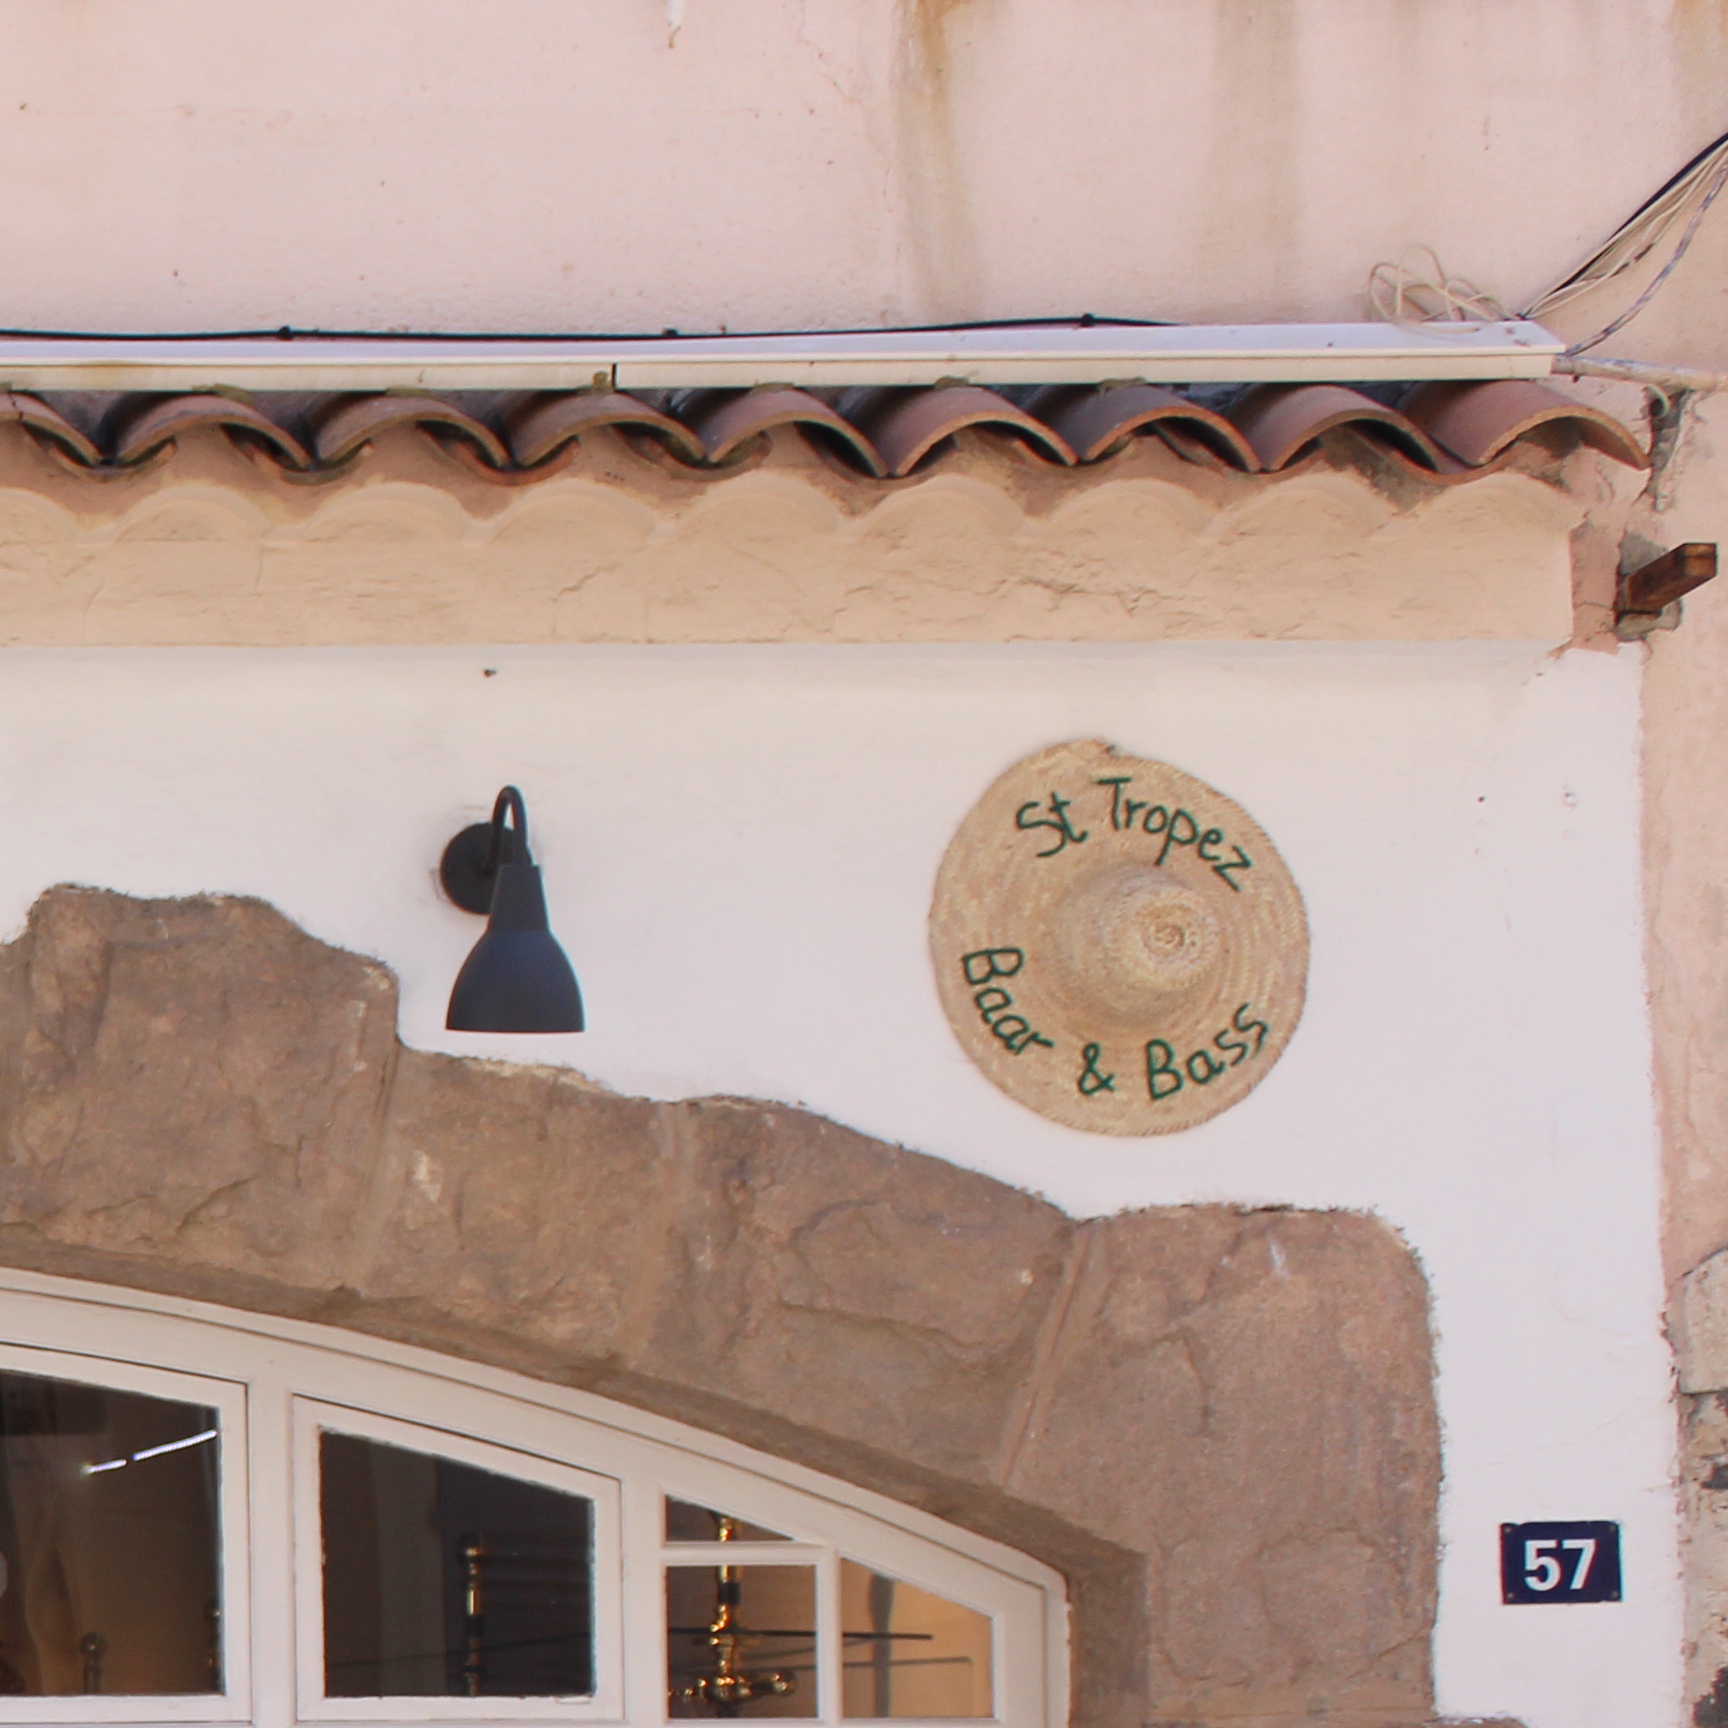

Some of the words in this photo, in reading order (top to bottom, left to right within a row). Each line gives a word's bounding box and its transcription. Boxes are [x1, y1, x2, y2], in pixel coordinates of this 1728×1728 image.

[1016, 792, 1090, 858] St
[1095, 776, 1254, 892] Tropez
[1077, 1043, 1116, 1097] &
[1146, 1002, 1270, 1101] Bass
[1523, 1538, 1597, 1592] 57
